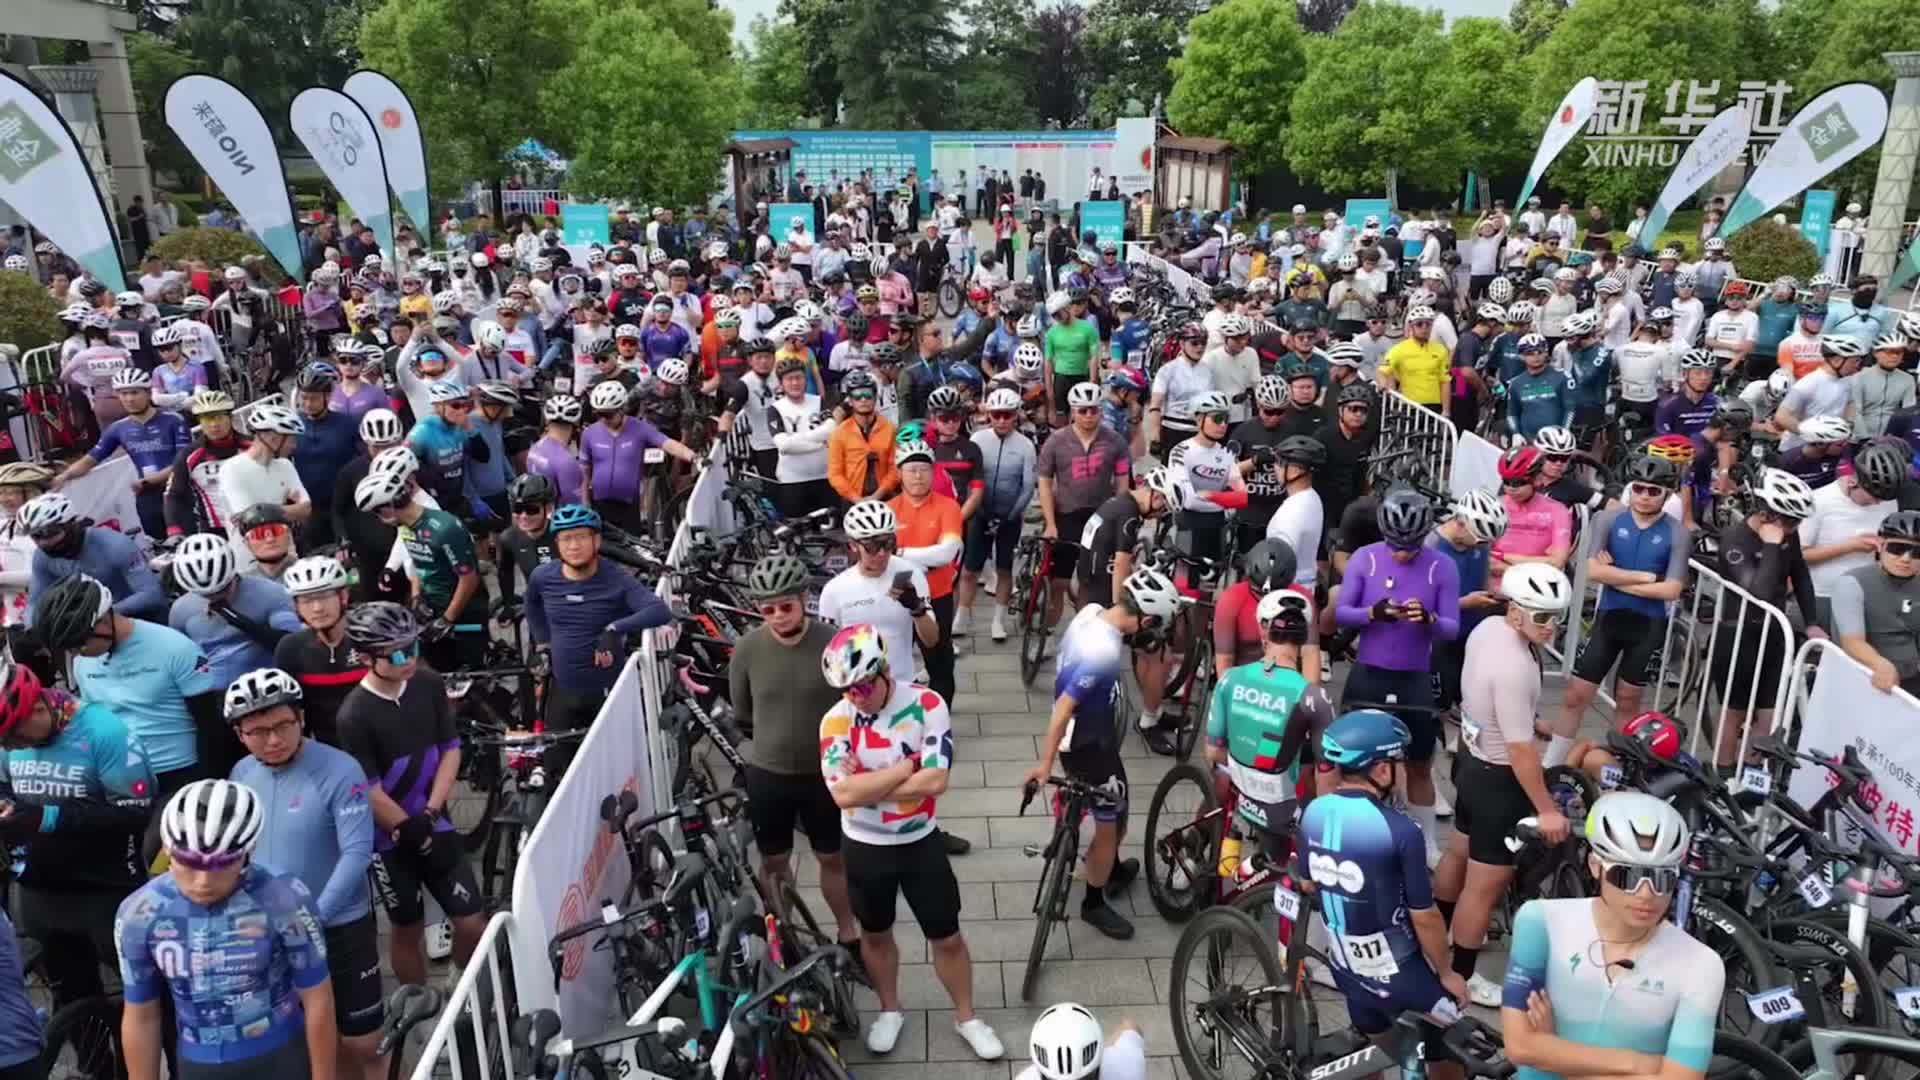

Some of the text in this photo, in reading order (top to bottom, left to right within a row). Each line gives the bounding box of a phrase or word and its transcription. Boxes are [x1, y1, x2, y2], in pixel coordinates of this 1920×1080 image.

[1808, 110, 1848, 147] 金典
[1072, 449, 1105, 480] EF
[1233, 684, 1287, 713] BORA
[1280, 892, 1294, 911] 317
[1350, 939, 1384, 960] 317
[1796, 925, 1850, 957] DT SWISS
[1762, 996, 1791, 1015] 409
[1309, 1044, 1377, 1080] SCOTT
